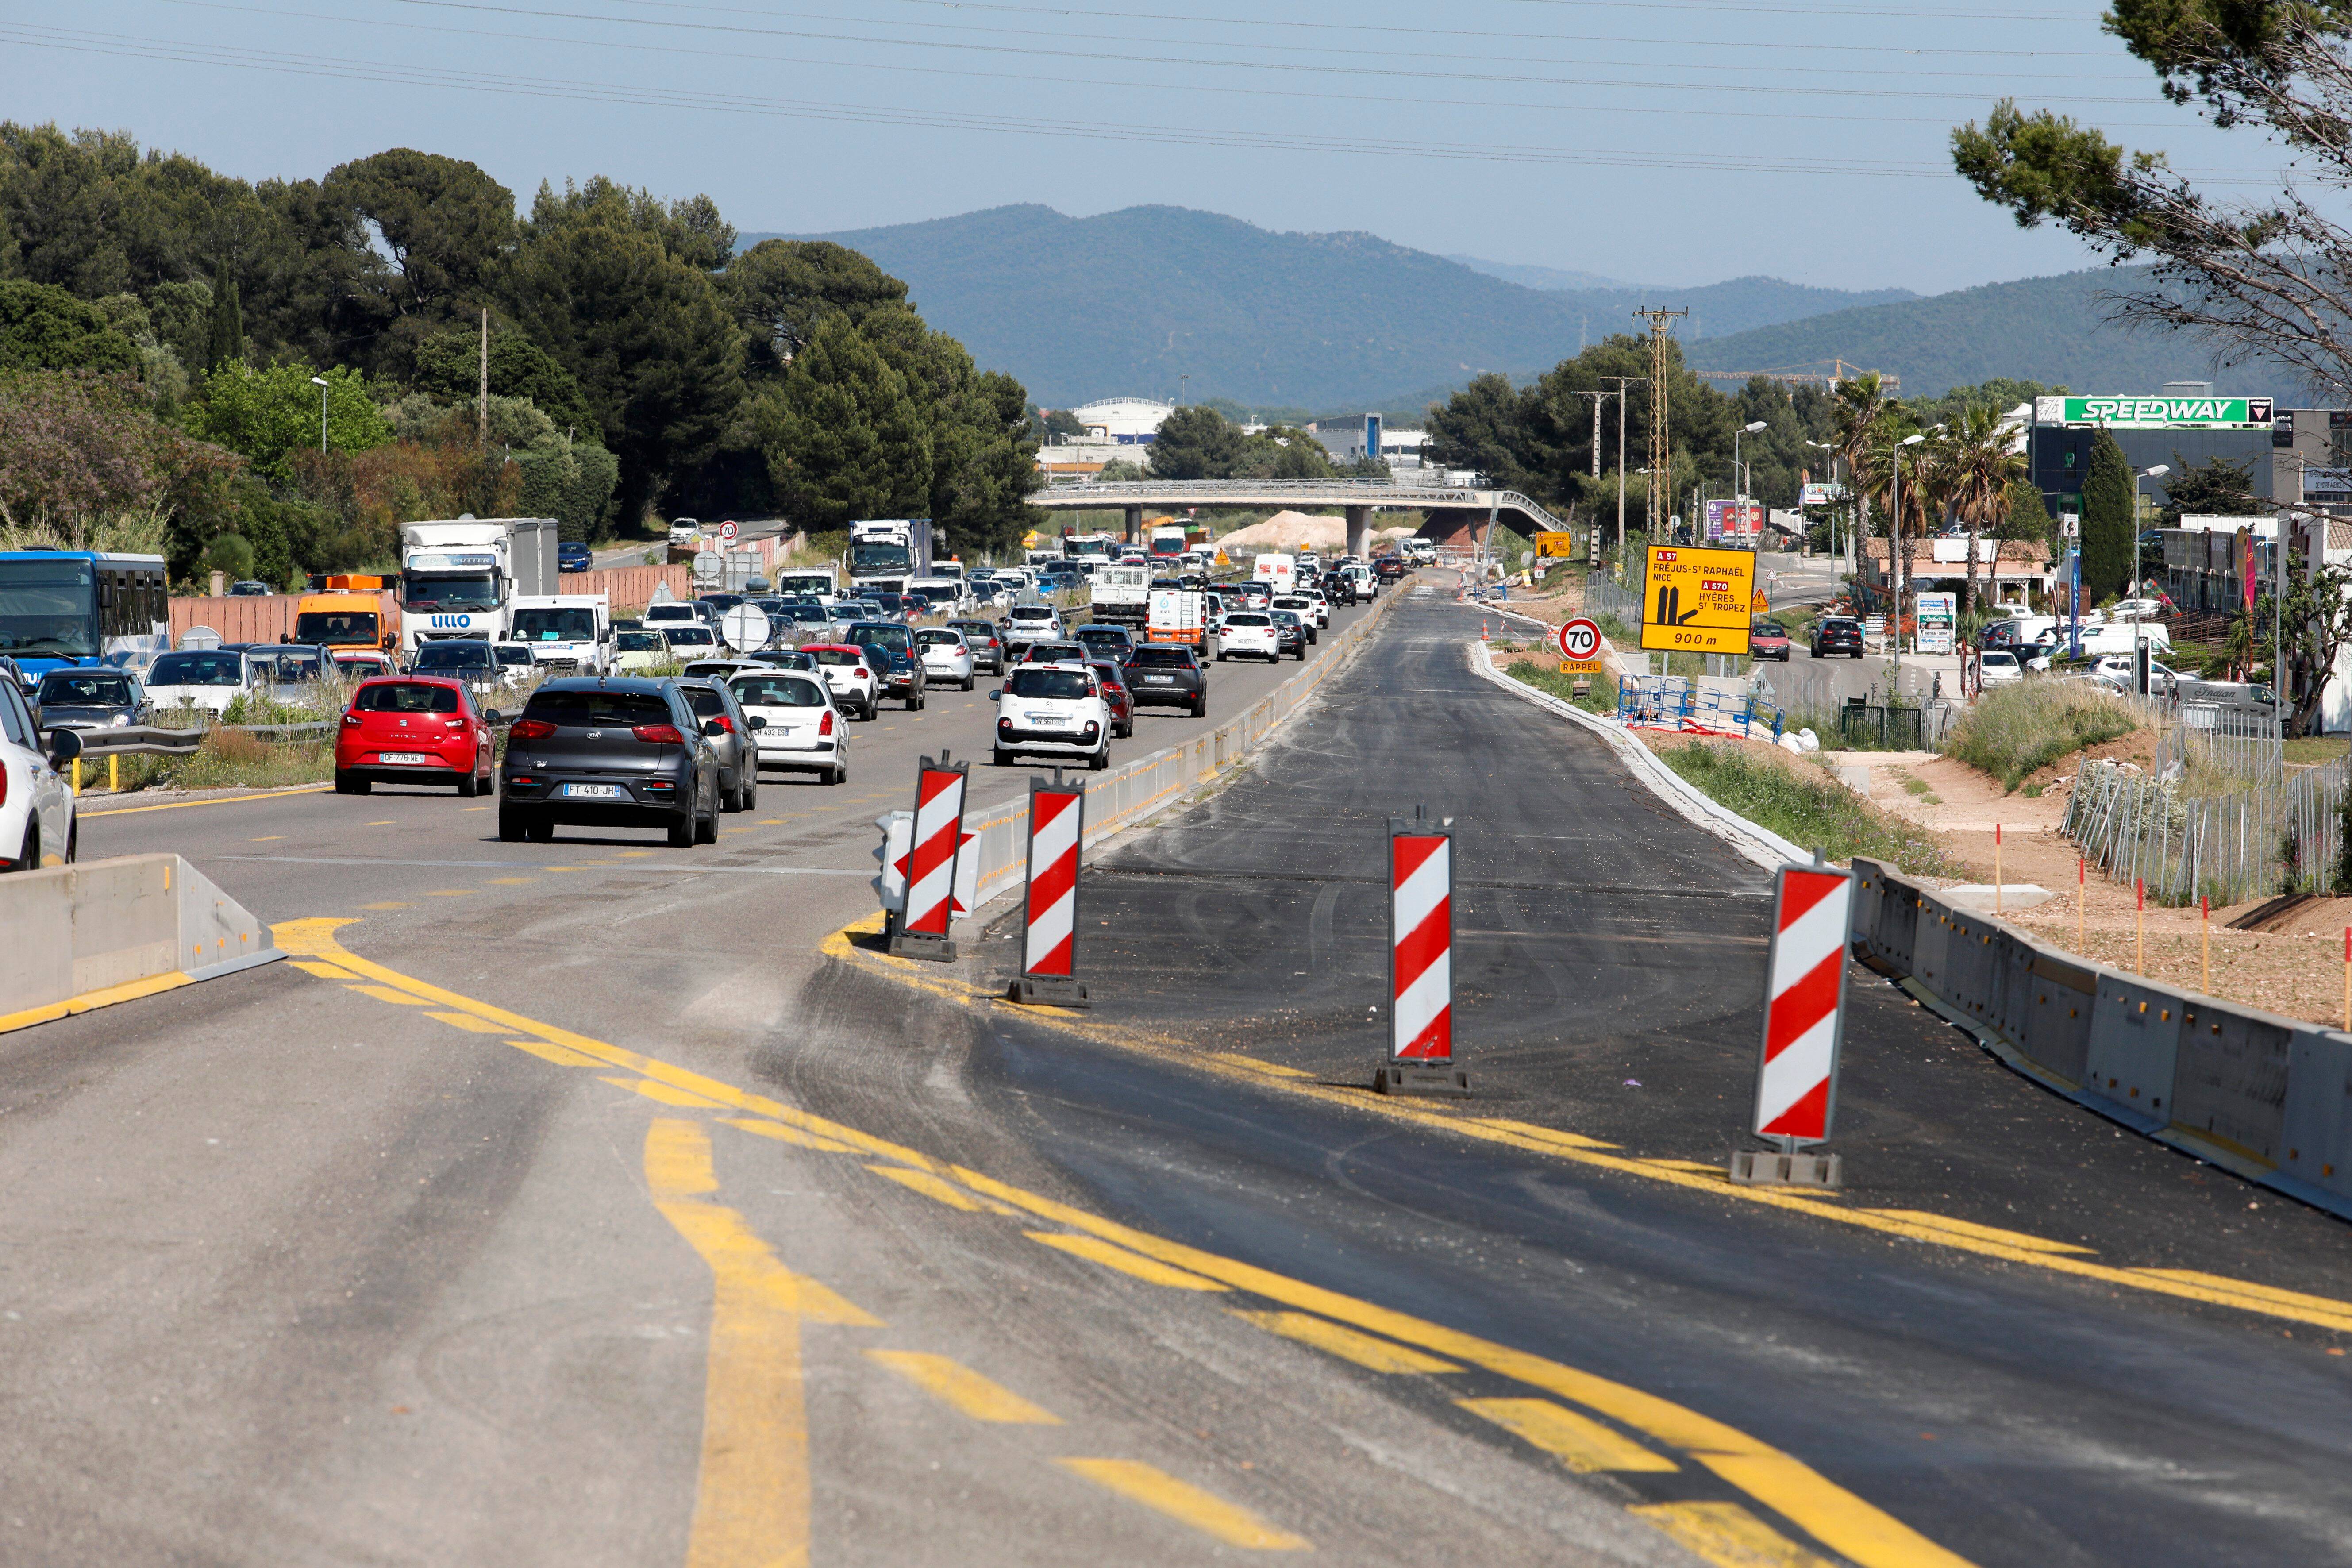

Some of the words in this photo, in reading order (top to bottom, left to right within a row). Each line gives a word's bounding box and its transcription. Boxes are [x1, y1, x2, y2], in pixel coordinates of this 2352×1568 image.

[2081, 401, 2232, 419] SPEEDWAY
[1704, 566, 1744, 577] RAPHAËL
[1699, 592, 1734, 602] HYÈRES
[1713, 604, 1745, 613] TROPEZ
[432, 615, 470, 628] LILLO
[1569, 631, 1593, 648] 70
[1675, 633, 1702, 644] 900
[2194, 686, 2236, 698] Indian
[569, 785, 614, 795] FT-410-JH
